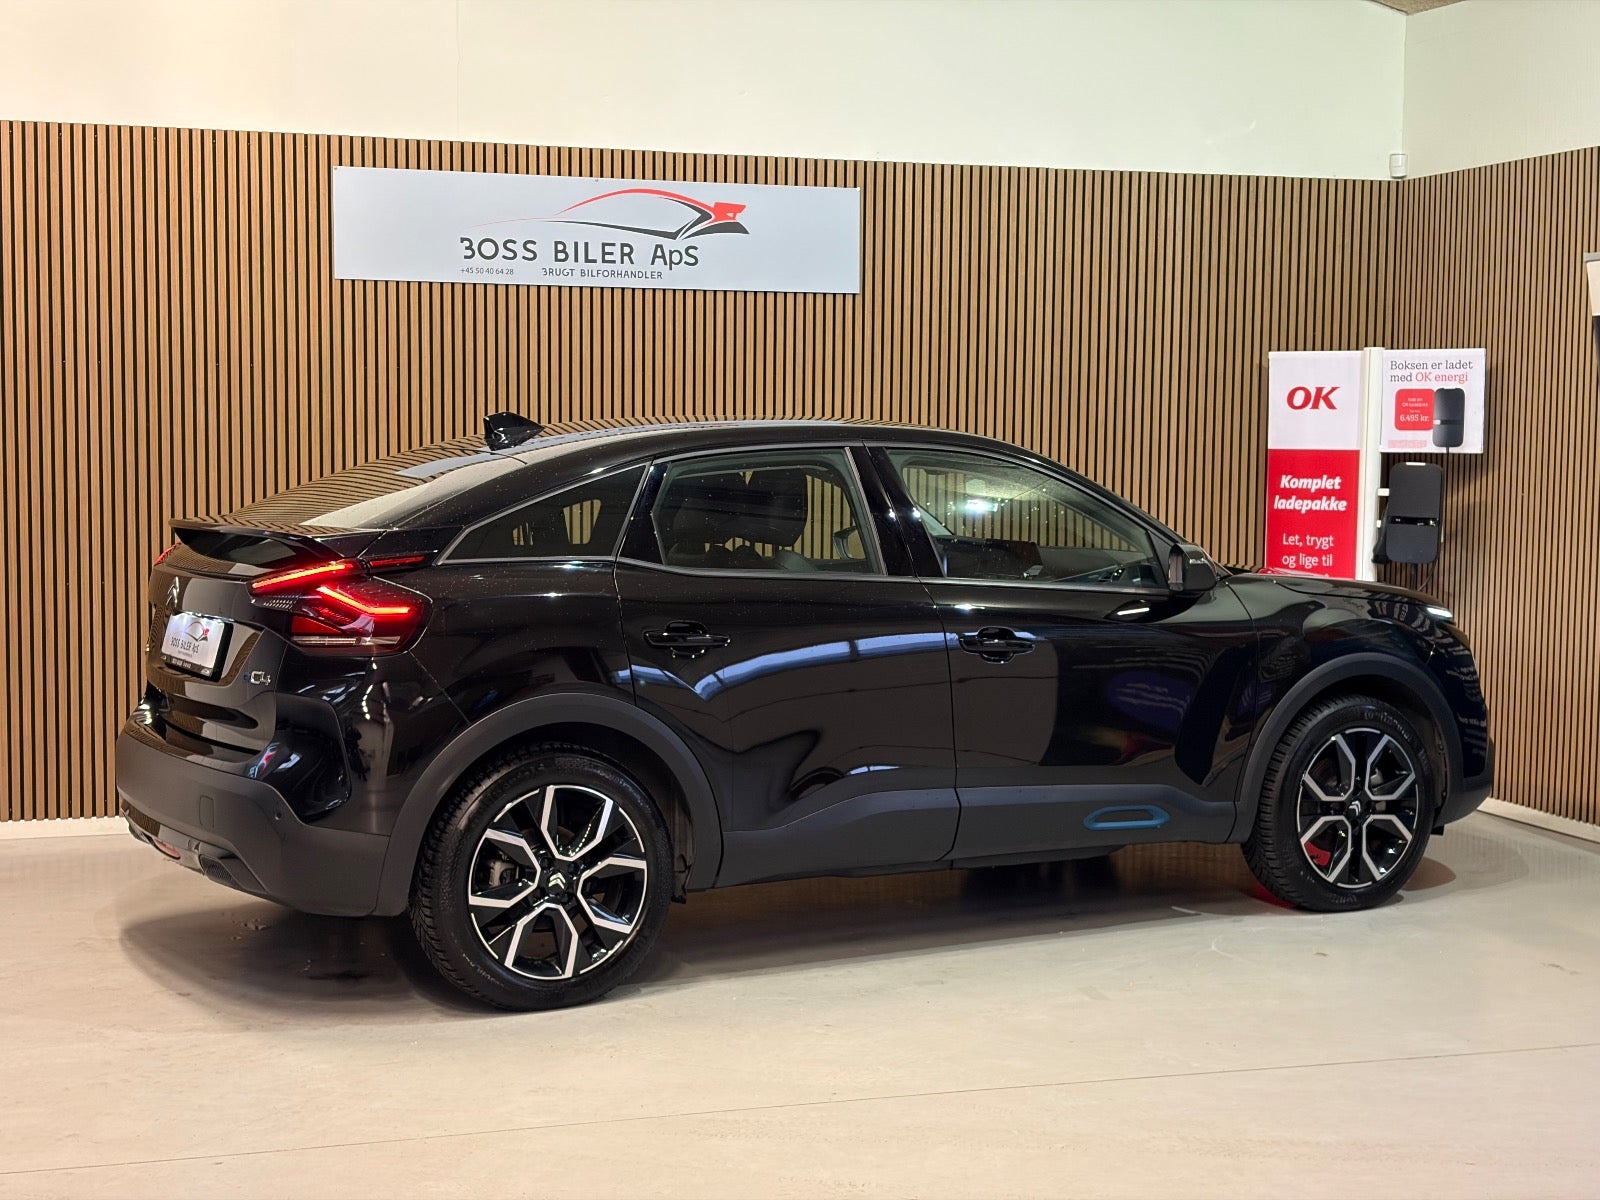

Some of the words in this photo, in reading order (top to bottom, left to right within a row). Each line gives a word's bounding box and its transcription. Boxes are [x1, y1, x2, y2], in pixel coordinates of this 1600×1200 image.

[554, 240, 635, 265] BILER
[651, 244, 699, 271] ApS
[485, 267, 494, 275] 40
[580, 268, 663, 279] BILFORHANDLER
[1390, 360, 1428, 370] Boksen
[1431, 362, 1442, 370] er
[1445, 360, 1473, 370] ladet
[1390, 372, 1413, 382] med
[1415, 372, 1432, 382] OK
[1434, 372, 1468, 385] energi
[1286, 386, 1340, 410] OK
[1399, 413, 1419, 422] 6.495
[1280, 474, 1342, 493] Komplet
[1273, 494, 1348, 514] ladepakke
[1282, 532, 1303, 547] Let,
[1305, 534, 1334, 550] trygt
[1282, 555, 1296, 569] og
[1299, 552, 1319, 569] lige
[1321, 553, 1333, 567] til
